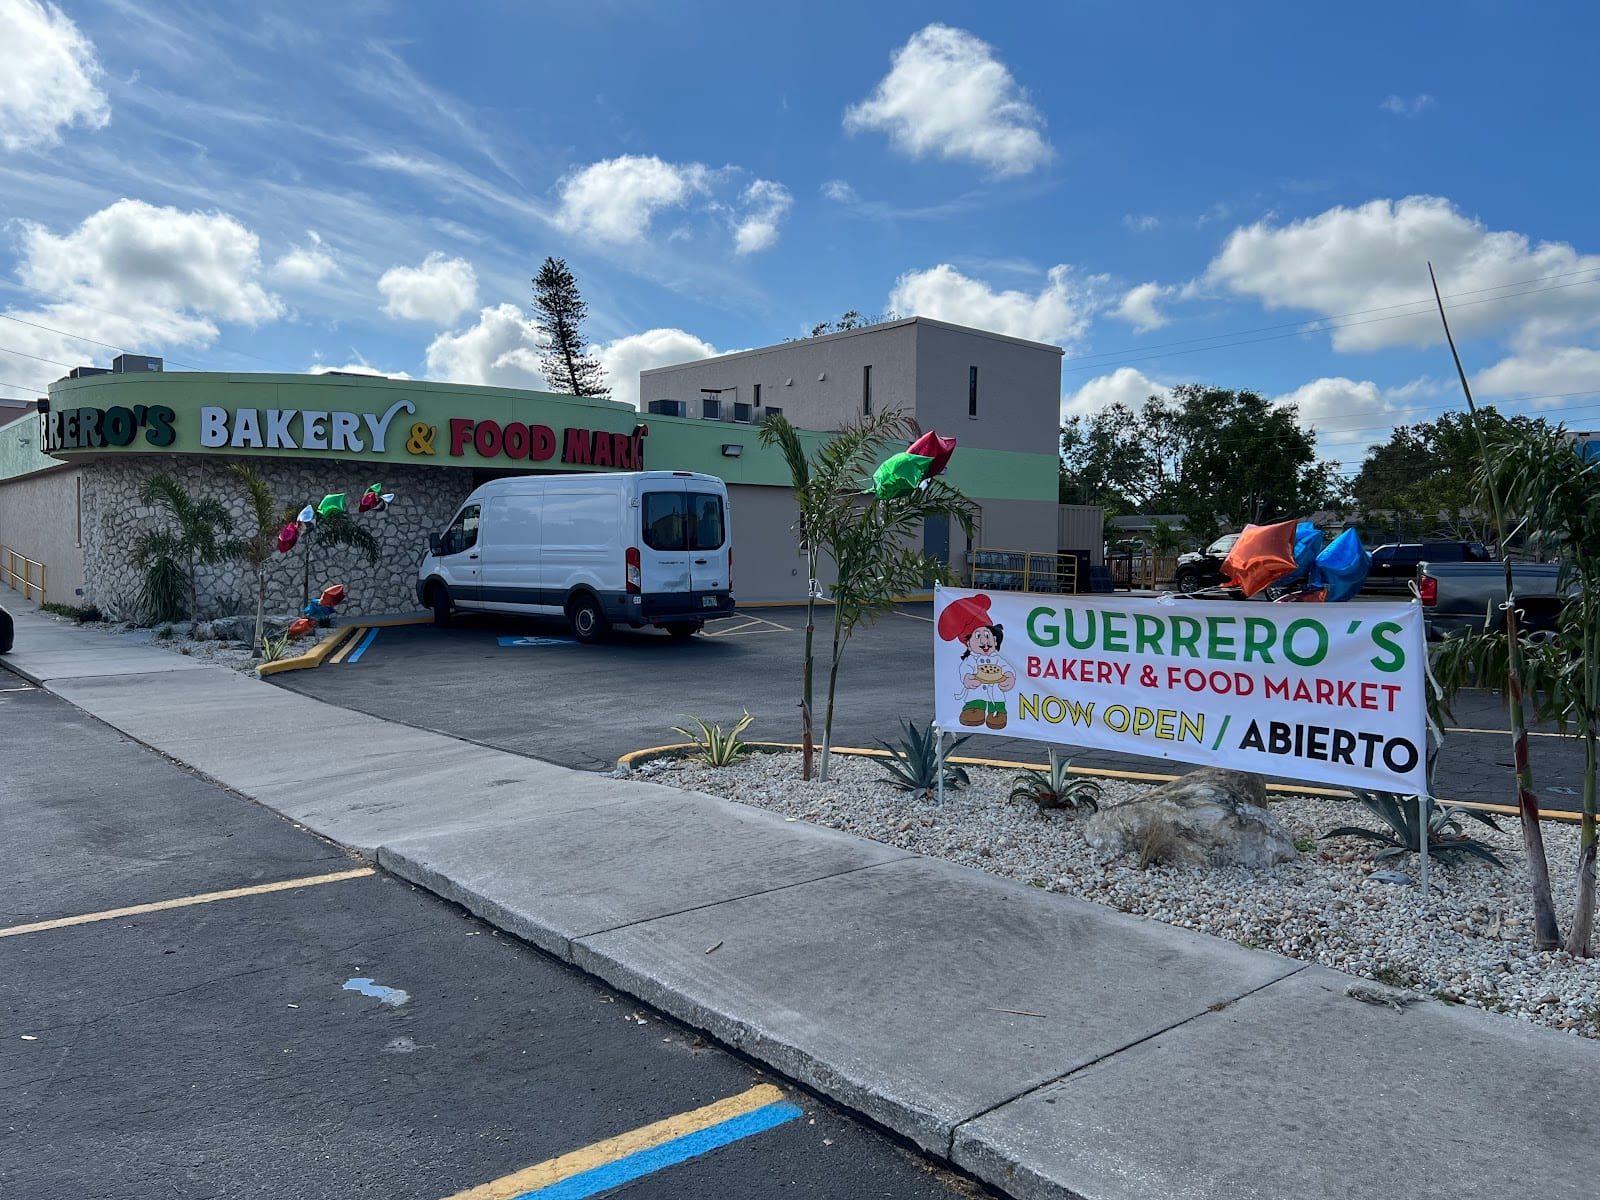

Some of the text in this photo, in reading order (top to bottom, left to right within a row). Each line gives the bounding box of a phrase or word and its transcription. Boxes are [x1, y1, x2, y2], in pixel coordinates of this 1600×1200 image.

[200, 399, 416, 453] BAKERY
[406, 422, 437, 455] &
[449, 418, 557, 461] FOOD
[1027, 656, 1402, 712] BAKERY & FOOD MARKET
[1019, 693, 1420, 775] NOW OPEN / ABIERTO
